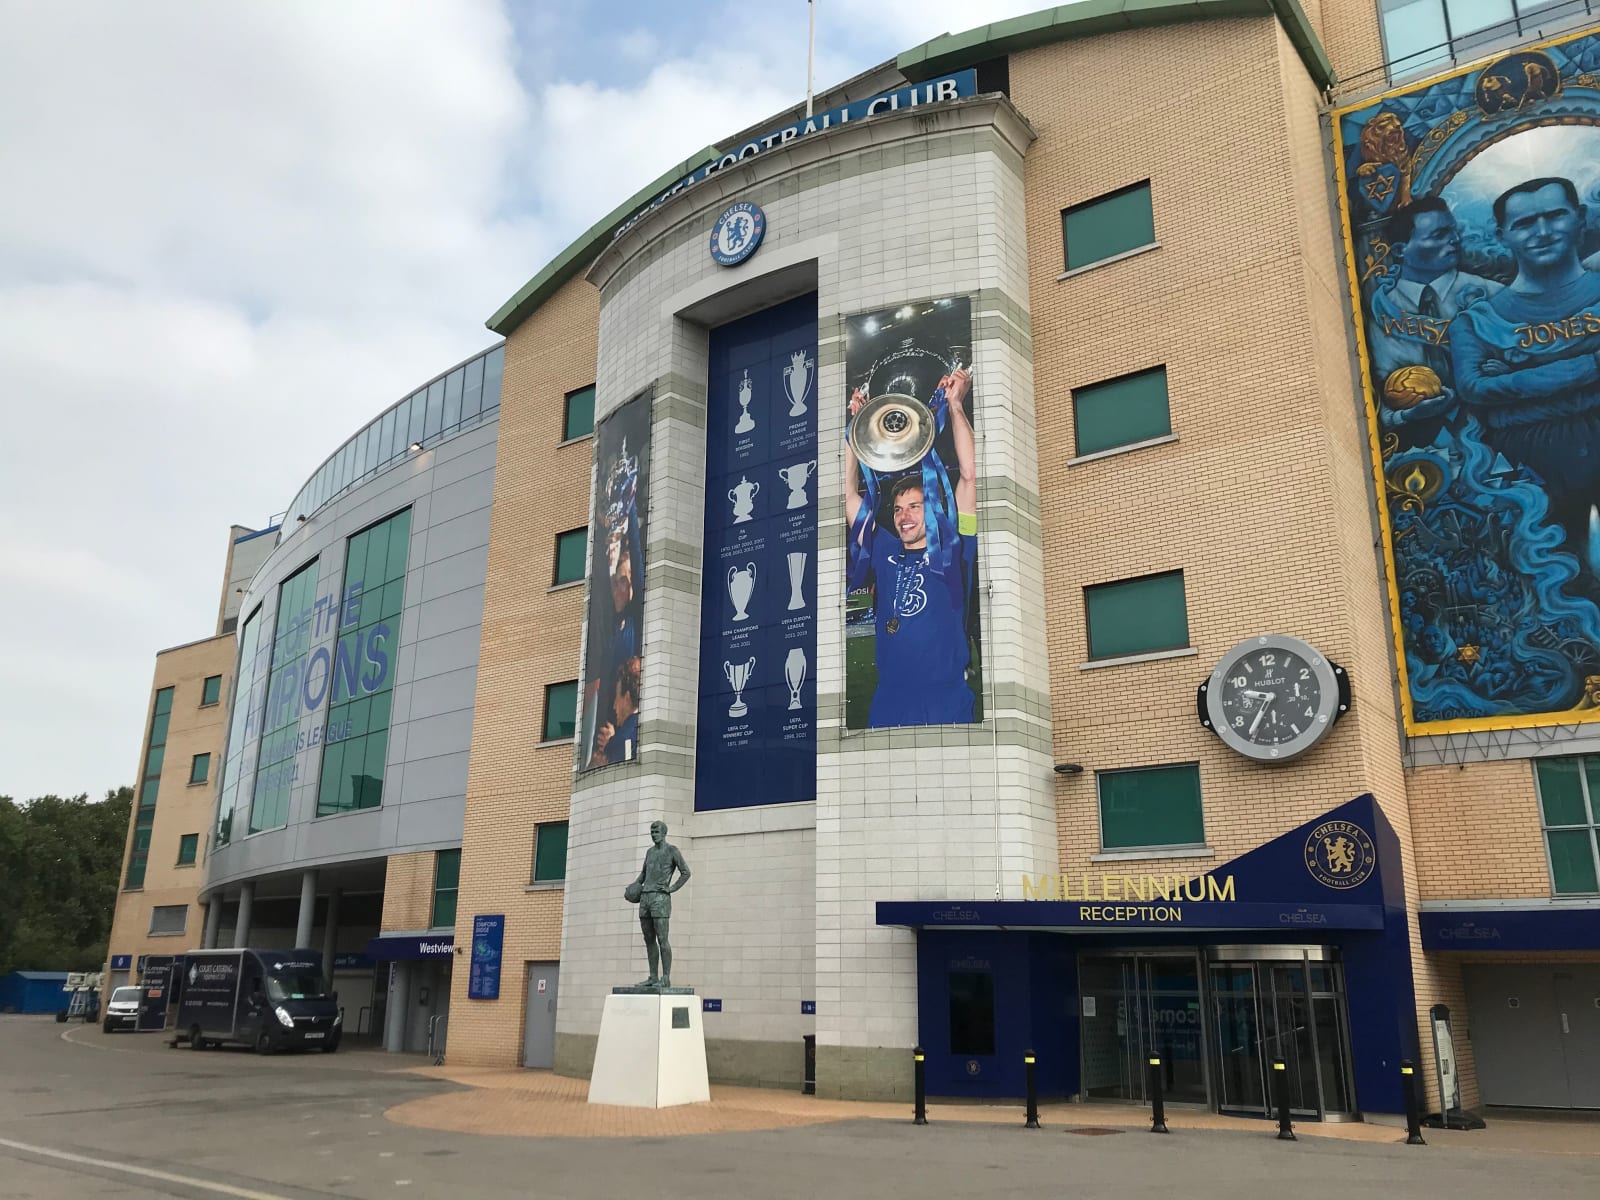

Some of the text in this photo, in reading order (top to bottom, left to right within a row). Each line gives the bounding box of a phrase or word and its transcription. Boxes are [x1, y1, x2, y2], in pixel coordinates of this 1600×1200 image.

[718, 203, 752, 225] CHELSEA
[1381, 309, 1450, 344] WEISZ
[1514, 312, 1600, 348] JONES
[788, 514, 806, 522] LEAGUE
[314, 580, 364, 638] THE
[1258, 654, 1276, 667] 12
[1300, 668, 1310, 680] 2
[1231, 676, 1247, 688] 10
[1254, 677, 1286, 687] HUBLOT
[1304, 706, 1314, 718] 4
[1235, 716, 1244, 727] 8
[1315, 823, 1359, 839] CHELSEA
[1318, 871, 1366, 886] FOOTBALL CLUB
[1022, 874, 1235, 902] MILLENNIUM
[932, 911, 980, 920] CHELSEA
[1080, 906, 1182, 922] RECEPTION
[1280, 913, 1327, 923] CHELSEA
[1439, 928, 1500, 939] CHELSEA
[420, 942, 454, 954] Westview
